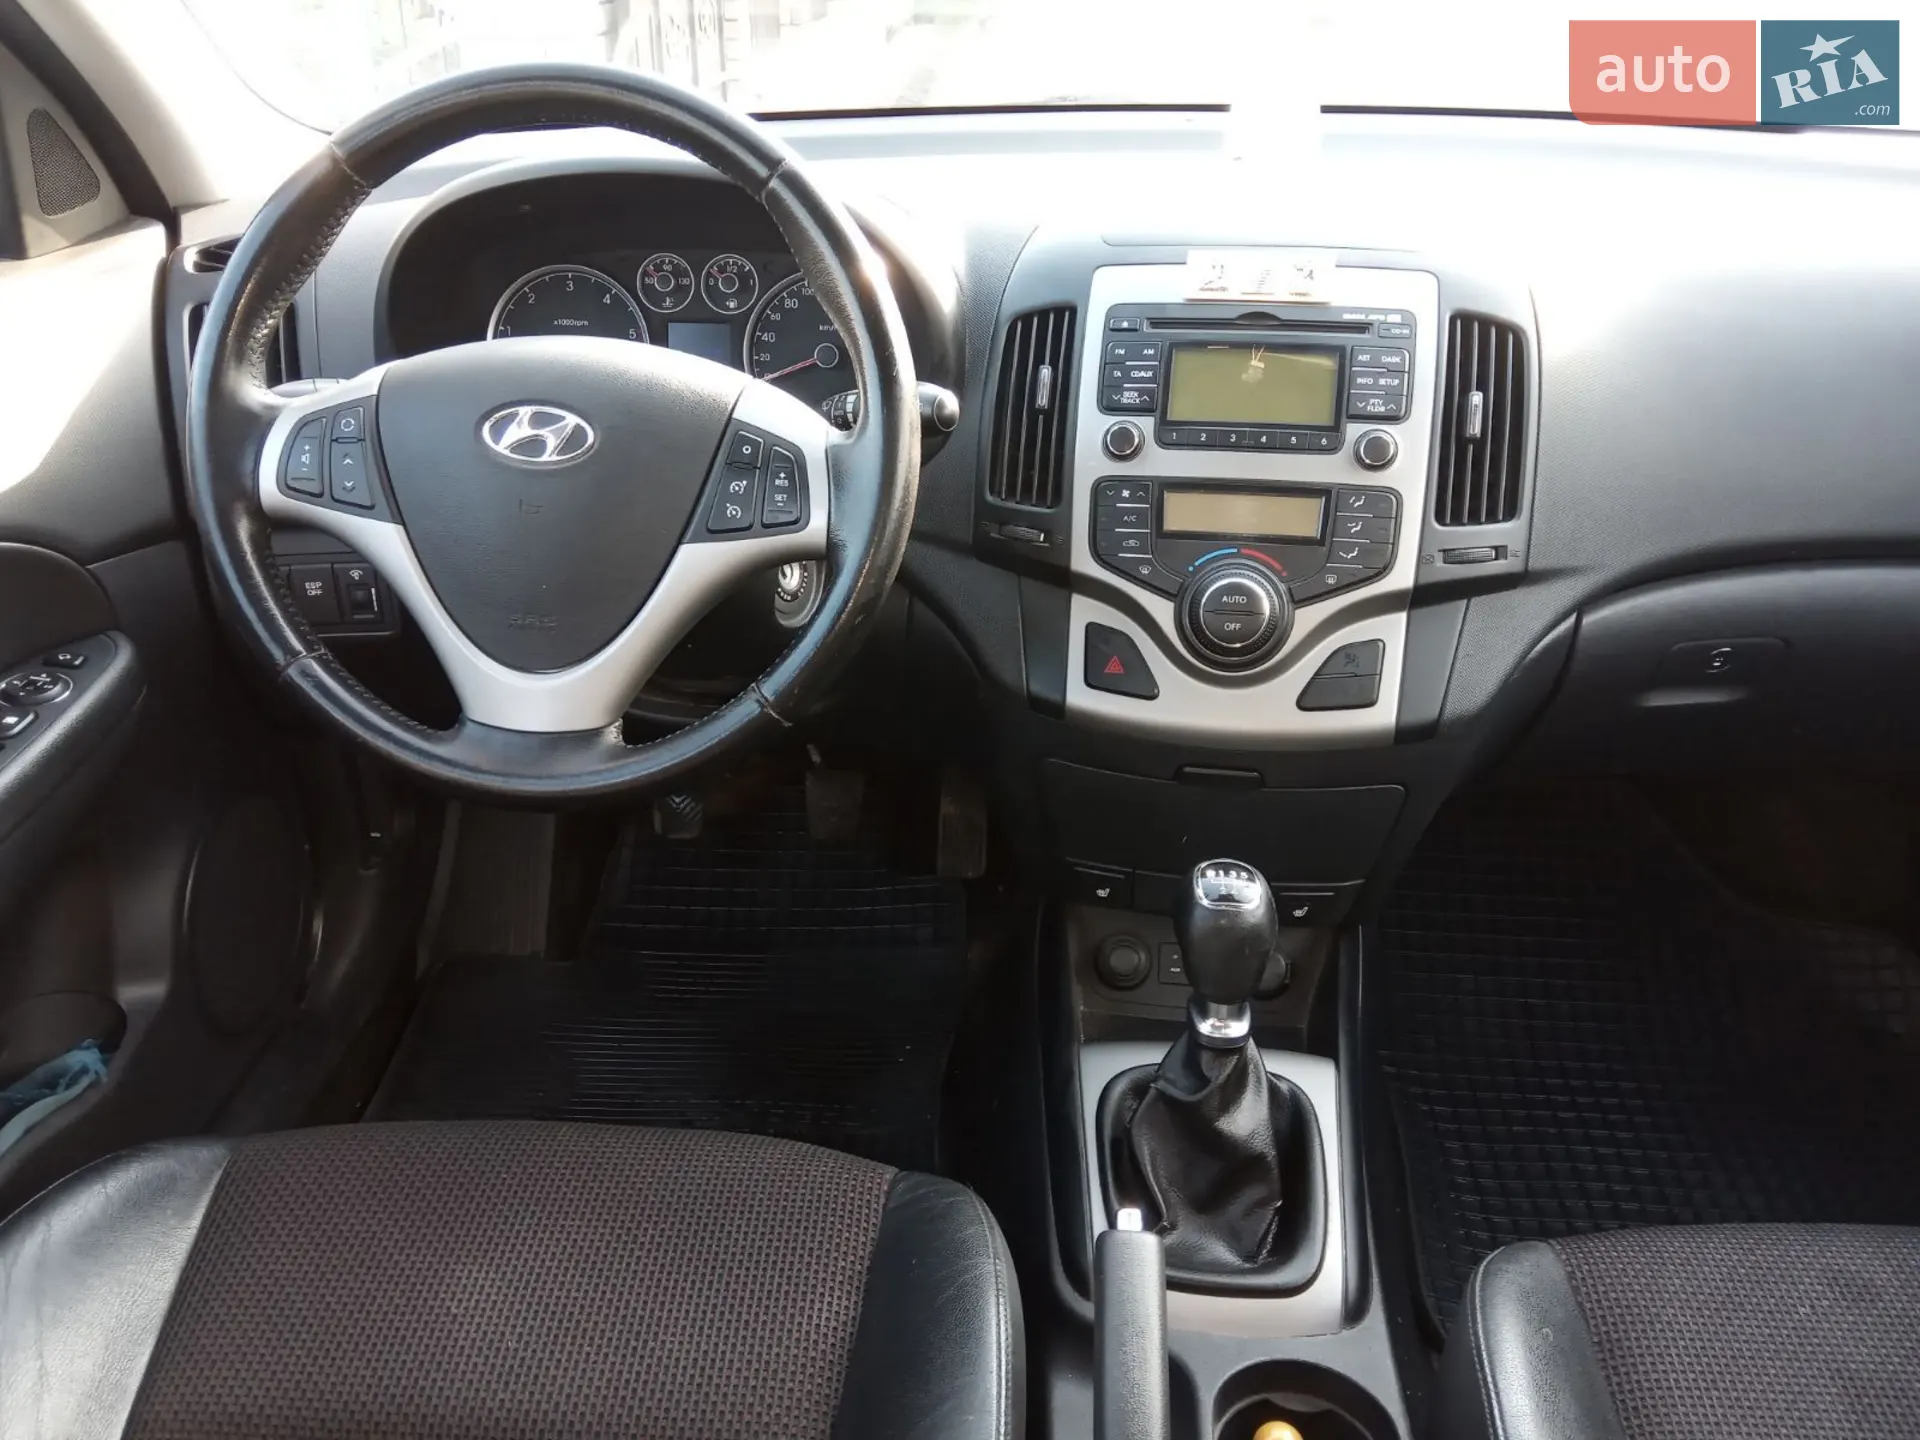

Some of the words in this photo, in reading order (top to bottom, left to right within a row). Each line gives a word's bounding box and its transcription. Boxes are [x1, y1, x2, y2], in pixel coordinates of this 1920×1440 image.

[663, 264, 673, 272] 90
[644, 277, 655, 285] 50
[678, 277, 690, 285] 130
[565, 280, 574, 292] 3
[528, 293, 535, 304] 2
[602, 294, 611, 305] 4
[784, 298, 799, 309] 80
[770, 313, 781, 321] 60
[628, 328, 638, 340] 5
[761, 331, 776, 343] 40
[760, 353, 771, 361] 20
[1113, 370, 1122, 378] TA
[1356, 377, 1374, 385] INFO
[1200, 433, 1207, 441] 2
[1230, 434, 1237, 442] 3
[1260, 435, 1267, 443] 4
[1290, 436, 1297, 445] 5
[1321, 437, 1328, 446] 6
[1123, 514, 1138, 523] A/C
[1222, 595, 1247, 604] AUTO
[1224, 621, 1242, 632] OFF
